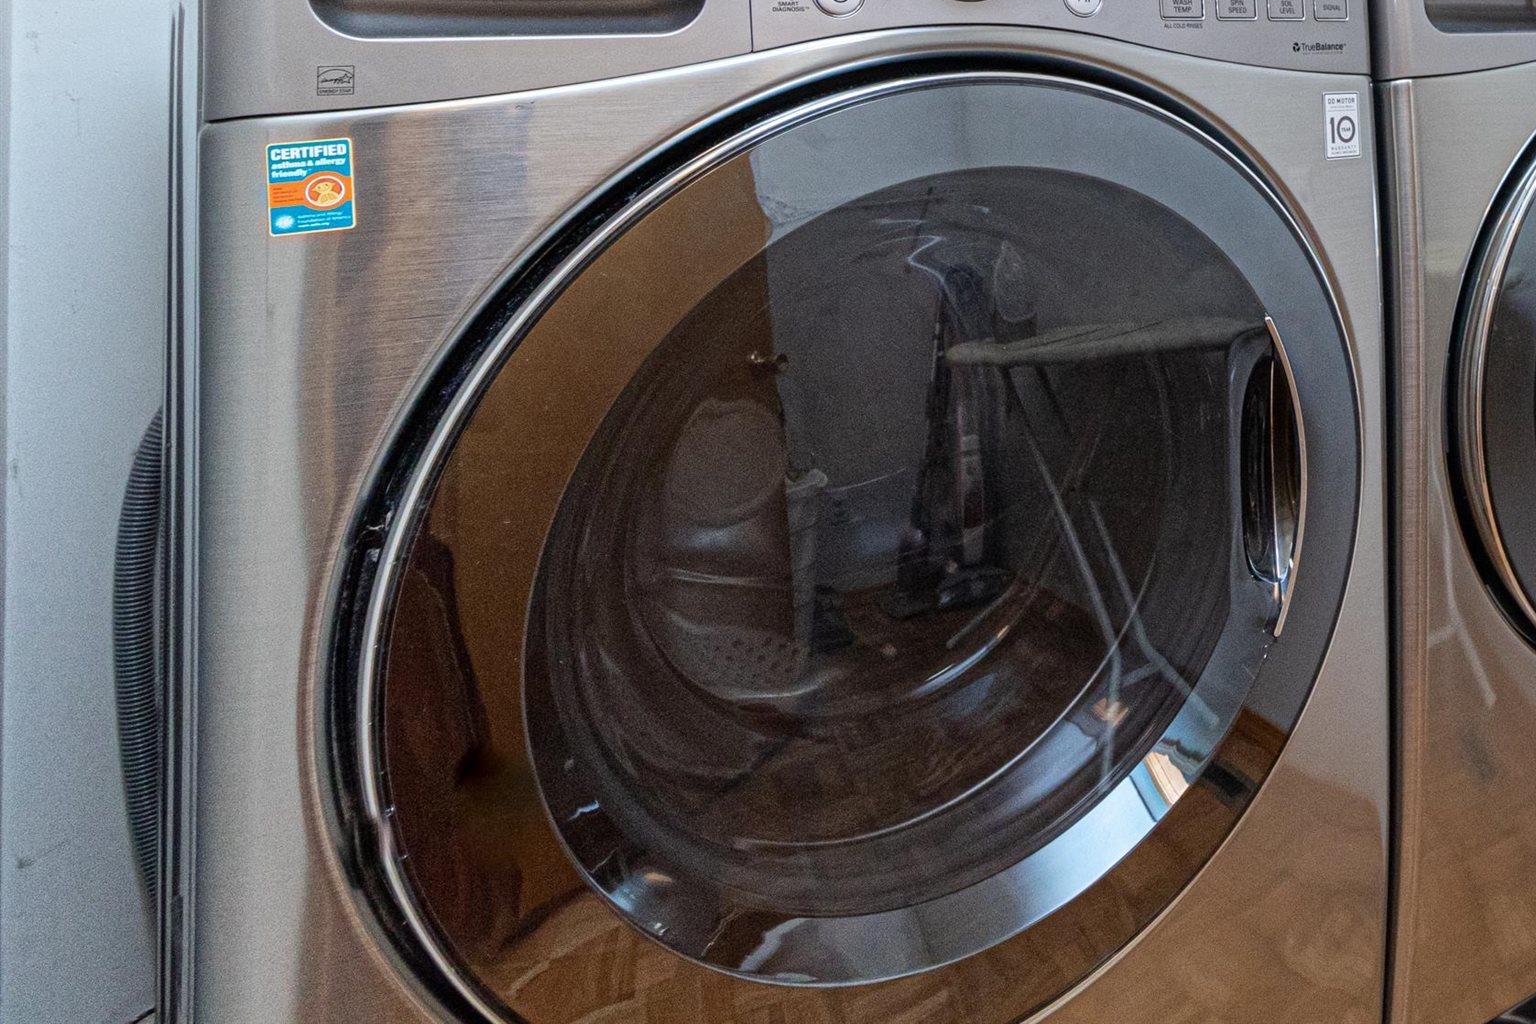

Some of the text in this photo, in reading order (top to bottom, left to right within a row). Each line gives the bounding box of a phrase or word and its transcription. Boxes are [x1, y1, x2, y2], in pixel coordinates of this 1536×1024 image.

[1330, 116, 1356, 144] 10
[270, 143, 347, 161] CERTIFIED
[271, 160, 306, 170] asthma
[314, 157, 346, 166] allergy
